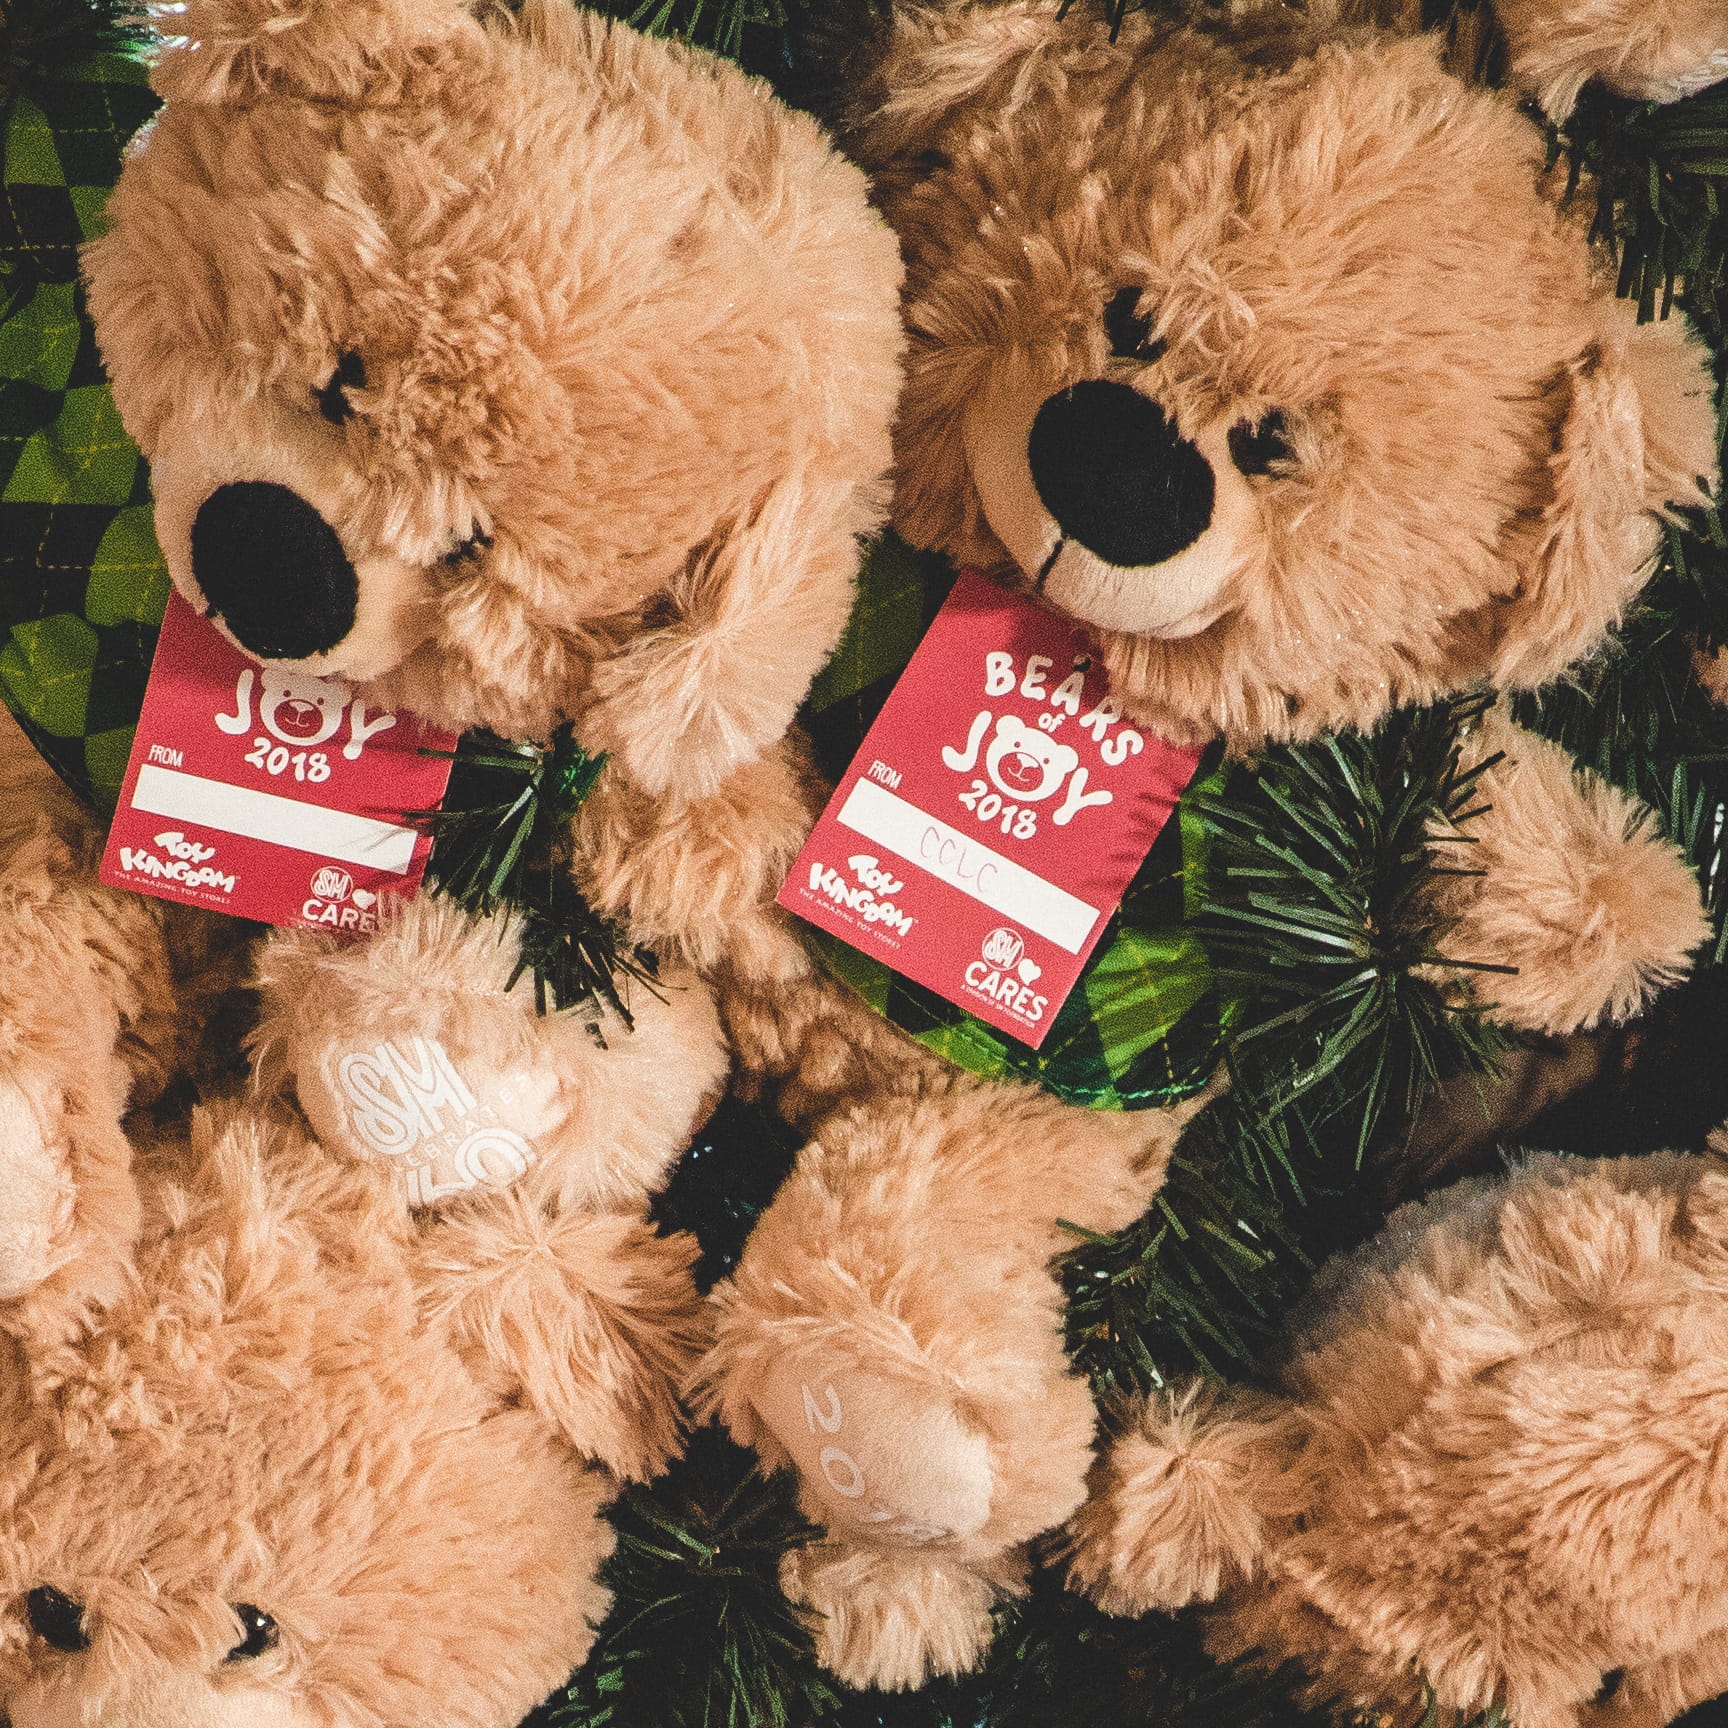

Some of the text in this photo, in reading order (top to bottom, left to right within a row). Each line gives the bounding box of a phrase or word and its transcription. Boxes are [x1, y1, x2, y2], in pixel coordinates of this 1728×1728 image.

[215, 668, 396, 761] JOY
[984, 650, 1145, 768] BEARS
[1038, 710, 1066, 733] of
[148, 744, 184, 767] FROM
[244, 736, 332, 783] 2018
[866, 759, 903, 791] FROM
[941, 710, 1114, 827] JOY
[958, 778, 1038, 841] 2018
[119, 846, 236, 894] KINGDOM
[153, 831, 216, 864] TOY
[847, 853, 905, 897] TOY
[302, 898, 378, 932] CARE
[808, 862, 915, 938] KINGDOM
[964, 960, 1049, 1024] CARES
[338, 1036, 477, 1155] SM
